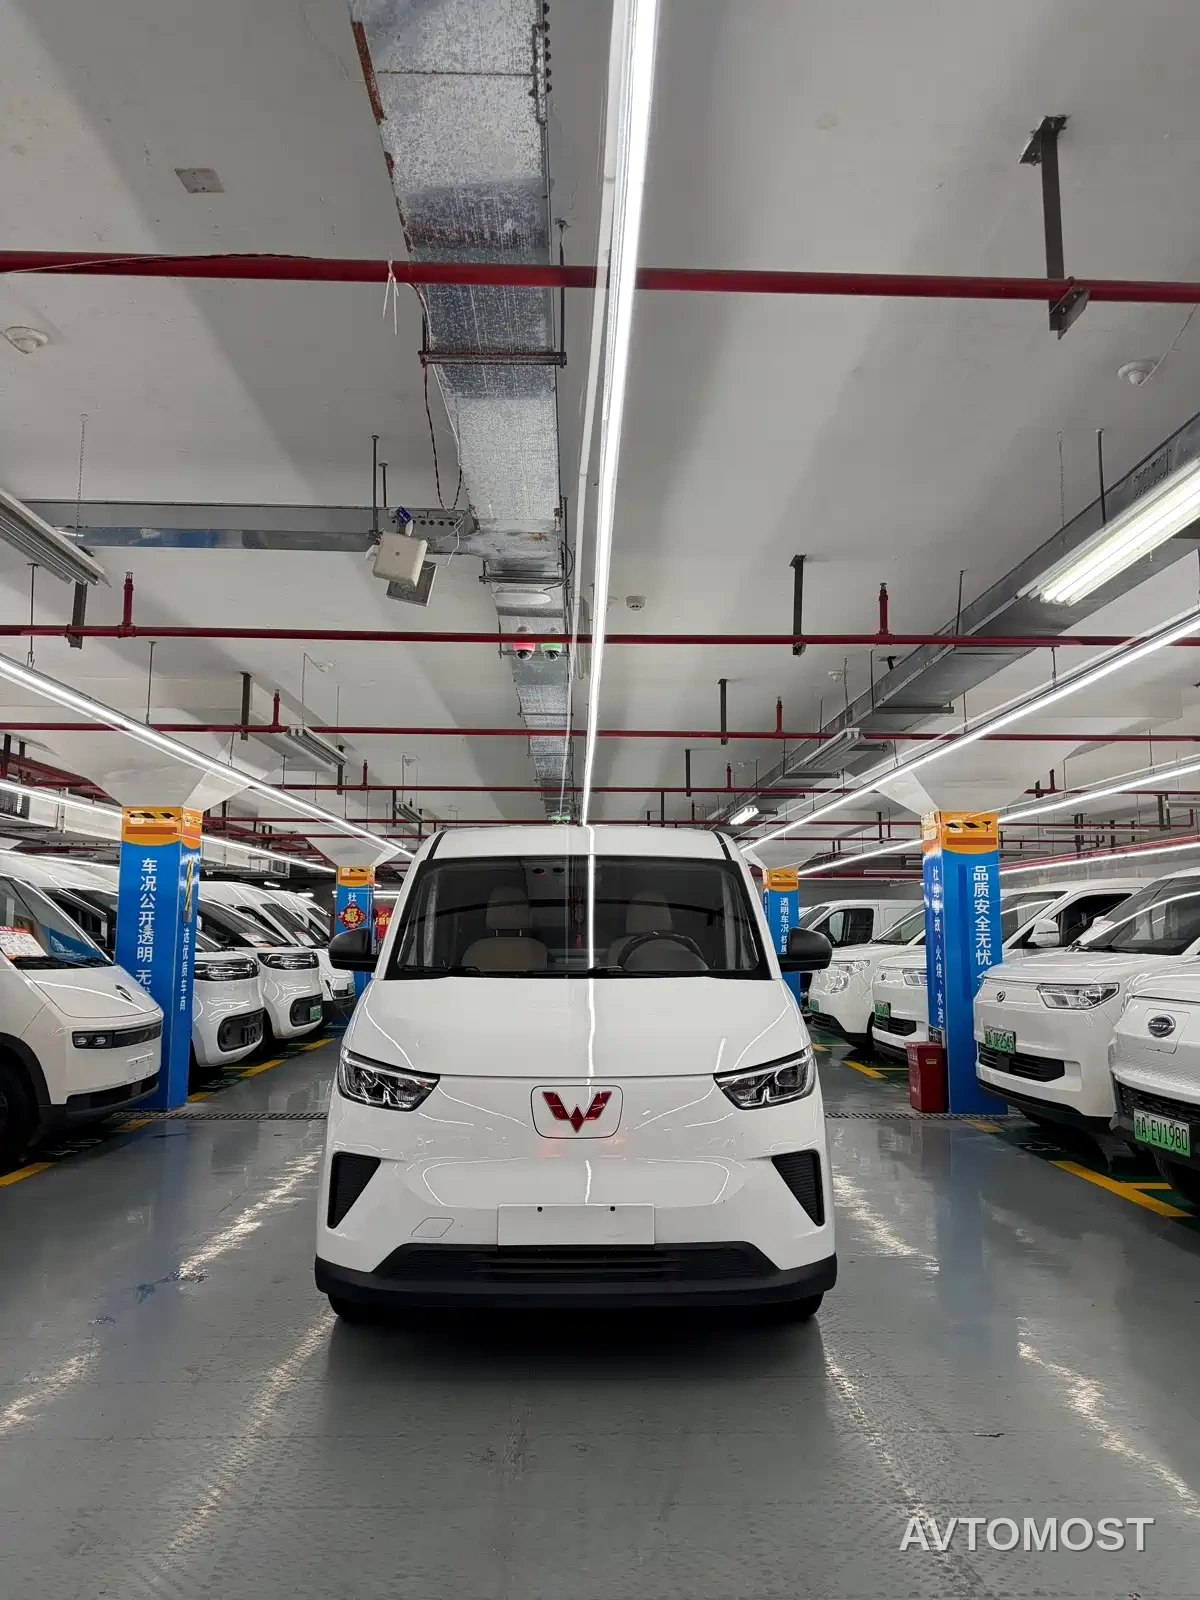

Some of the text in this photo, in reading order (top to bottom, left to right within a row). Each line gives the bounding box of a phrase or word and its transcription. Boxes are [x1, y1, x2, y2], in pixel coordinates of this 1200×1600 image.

[137, 857, 158, 963] 车况公开透明
[973, 865, 993, 966] 品质安全无忧
